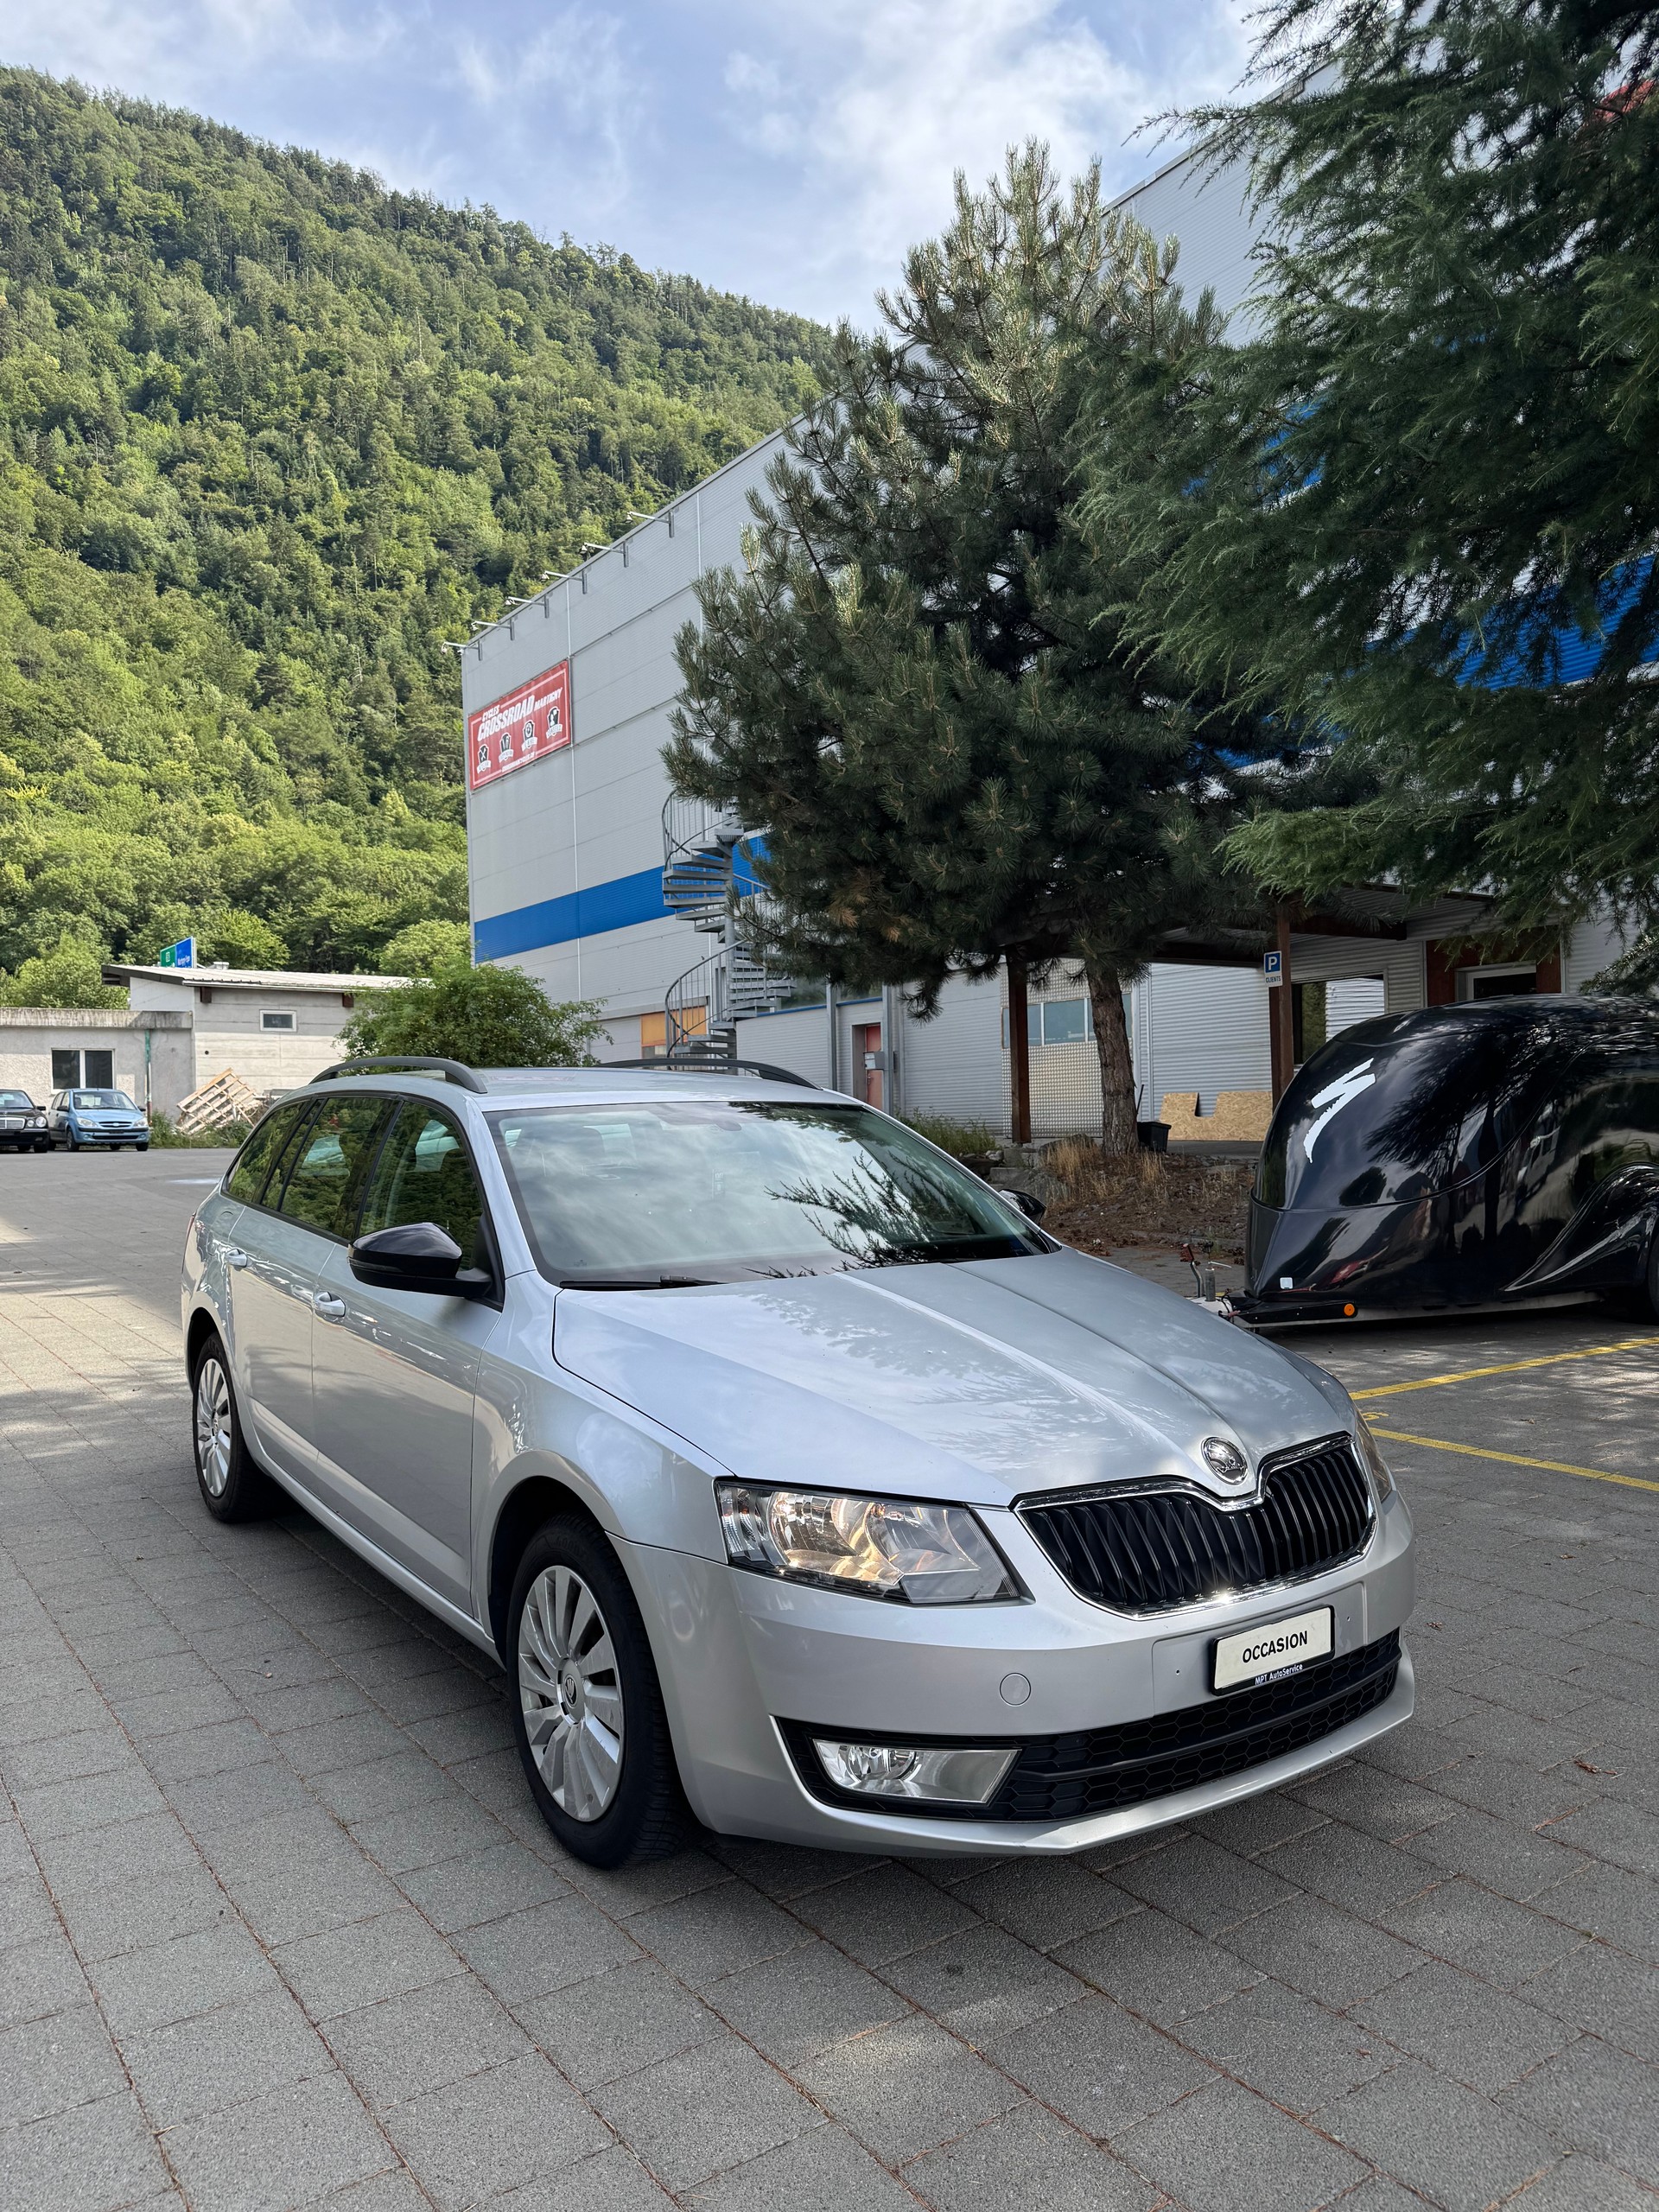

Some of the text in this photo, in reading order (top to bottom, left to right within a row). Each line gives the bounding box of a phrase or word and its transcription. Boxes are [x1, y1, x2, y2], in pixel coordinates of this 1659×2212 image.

[477, 695, 535, 741] CROSSROAD
[481, 704, 500, 722] CYCLES
[1268, 956, 1278, 970] P
[1243, 1630, 1307, 1663] OCCASION
[1255, 1663, 1303, 1686] MPT AutoService
